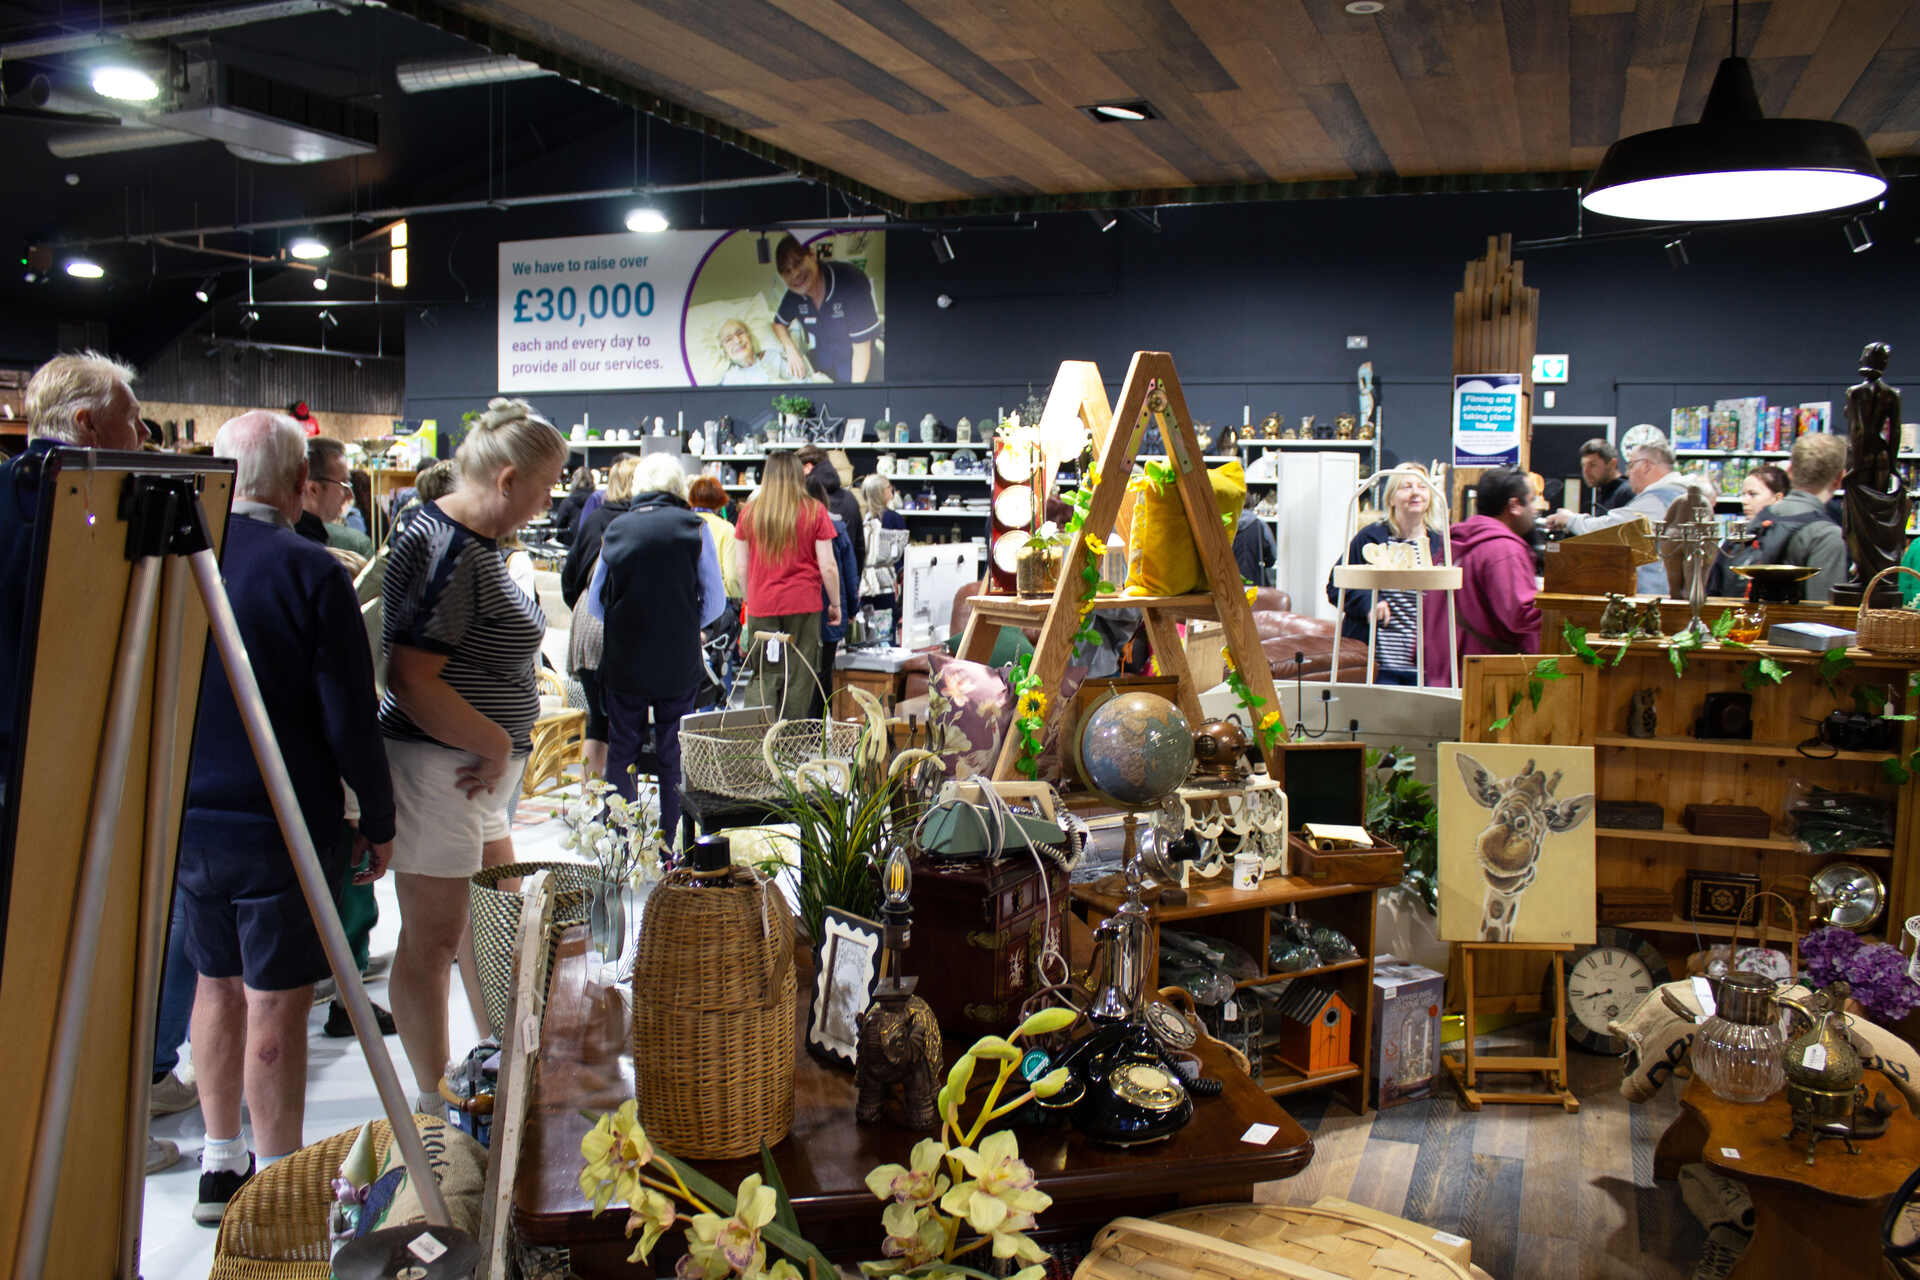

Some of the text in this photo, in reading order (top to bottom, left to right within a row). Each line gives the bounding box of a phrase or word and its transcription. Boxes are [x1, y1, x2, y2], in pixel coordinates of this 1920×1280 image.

[512, 256, 649, 275] We have to raise over
[514, 281, 655, 327] £30,000
[512, 334, 650, 353] each and every day to
[512, 357, 663, 374] provide all our services.
